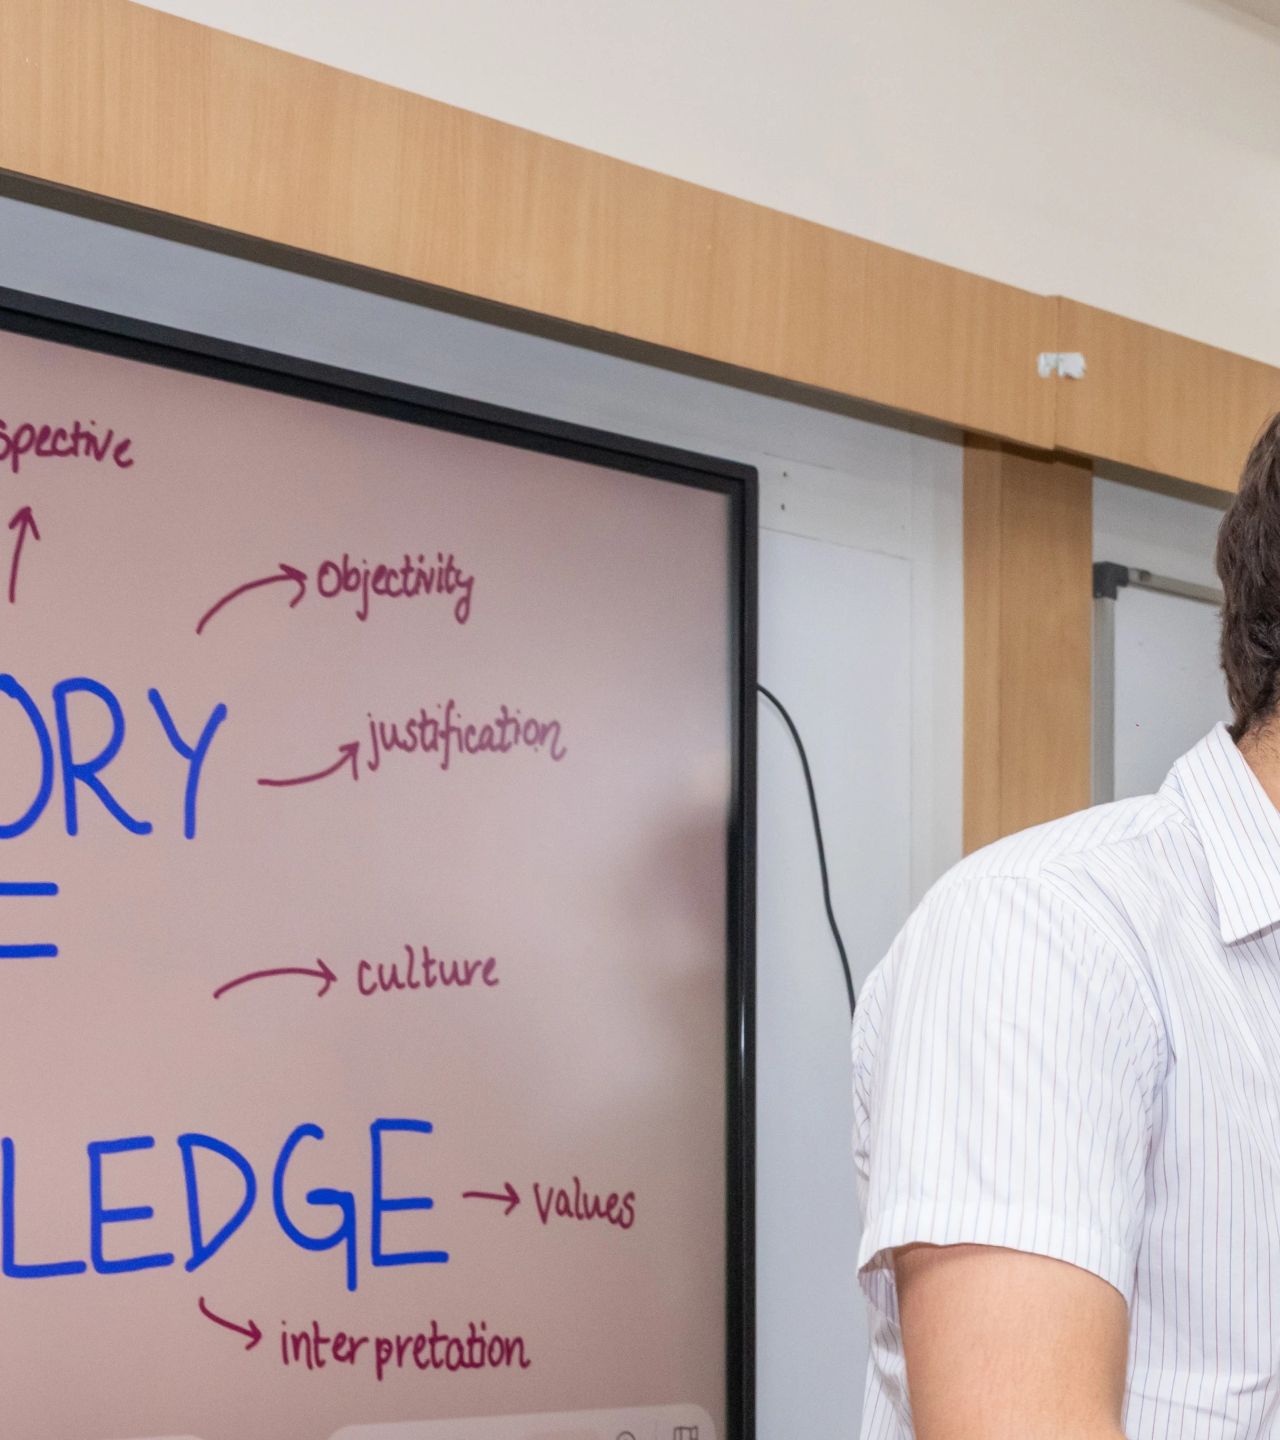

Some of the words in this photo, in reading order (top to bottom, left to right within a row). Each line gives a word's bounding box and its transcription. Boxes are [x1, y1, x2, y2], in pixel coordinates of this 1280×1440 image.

[317, 553, 474, 624] Objectivity
[366, 699, 567, 770] justification
[357, 945, 500, 996] culture
[2, 1118, 450, 1291] LEDGE
[533, 1177, 636, 1229] values
[280, 1320, 531, 1381] interpretation
